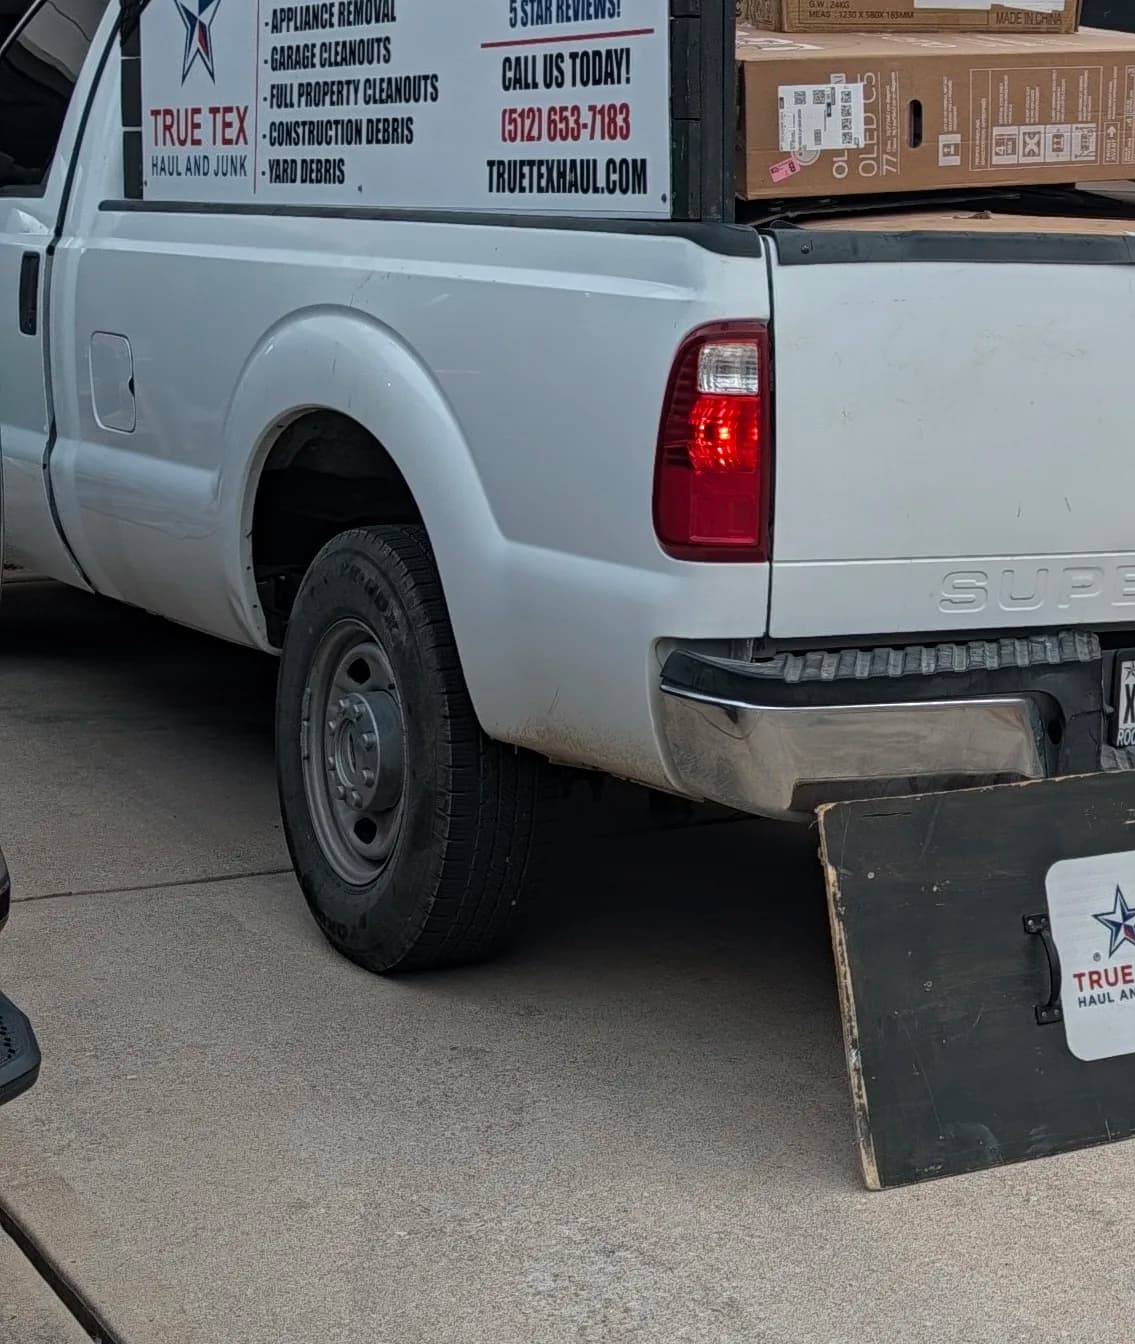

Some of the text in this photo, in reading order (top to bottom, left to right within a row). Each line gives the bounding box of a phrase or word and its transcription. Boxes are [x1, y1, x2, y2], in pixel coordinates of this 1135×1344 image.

[271, 1, 335, 34] APPLIANCE
[996, 12, 1062, 26] MADE IN CHINA
[271, 36, 391, 72] GARAGE CLEANOUTS
[502, 47, 631, 91] CALL US TODAY!
[269, 73, 439, 109] FULL PROPERTY CLEANOUTS
[150, 105, 249, 146] TRUE TEX
[269, 116, 414, 147] CONSTRUCTION DEBRIS
[501, 102, 631, 143] (512) 653-7183
[858, 113, 878, 177] OLED
[151, 155, 248, 177] HAUL AND JUNK
[268, 158, 345, 184] YARD DEBRIS
[487, 158, 648, 195] TRUETEXHAUL.COM
[832, 150, 848, 179] OL
[882, 154, 897, 176] 77
[1073, 964, 1135, 993] TRUE
[1077, 991, 1115, 1008] HAUL
